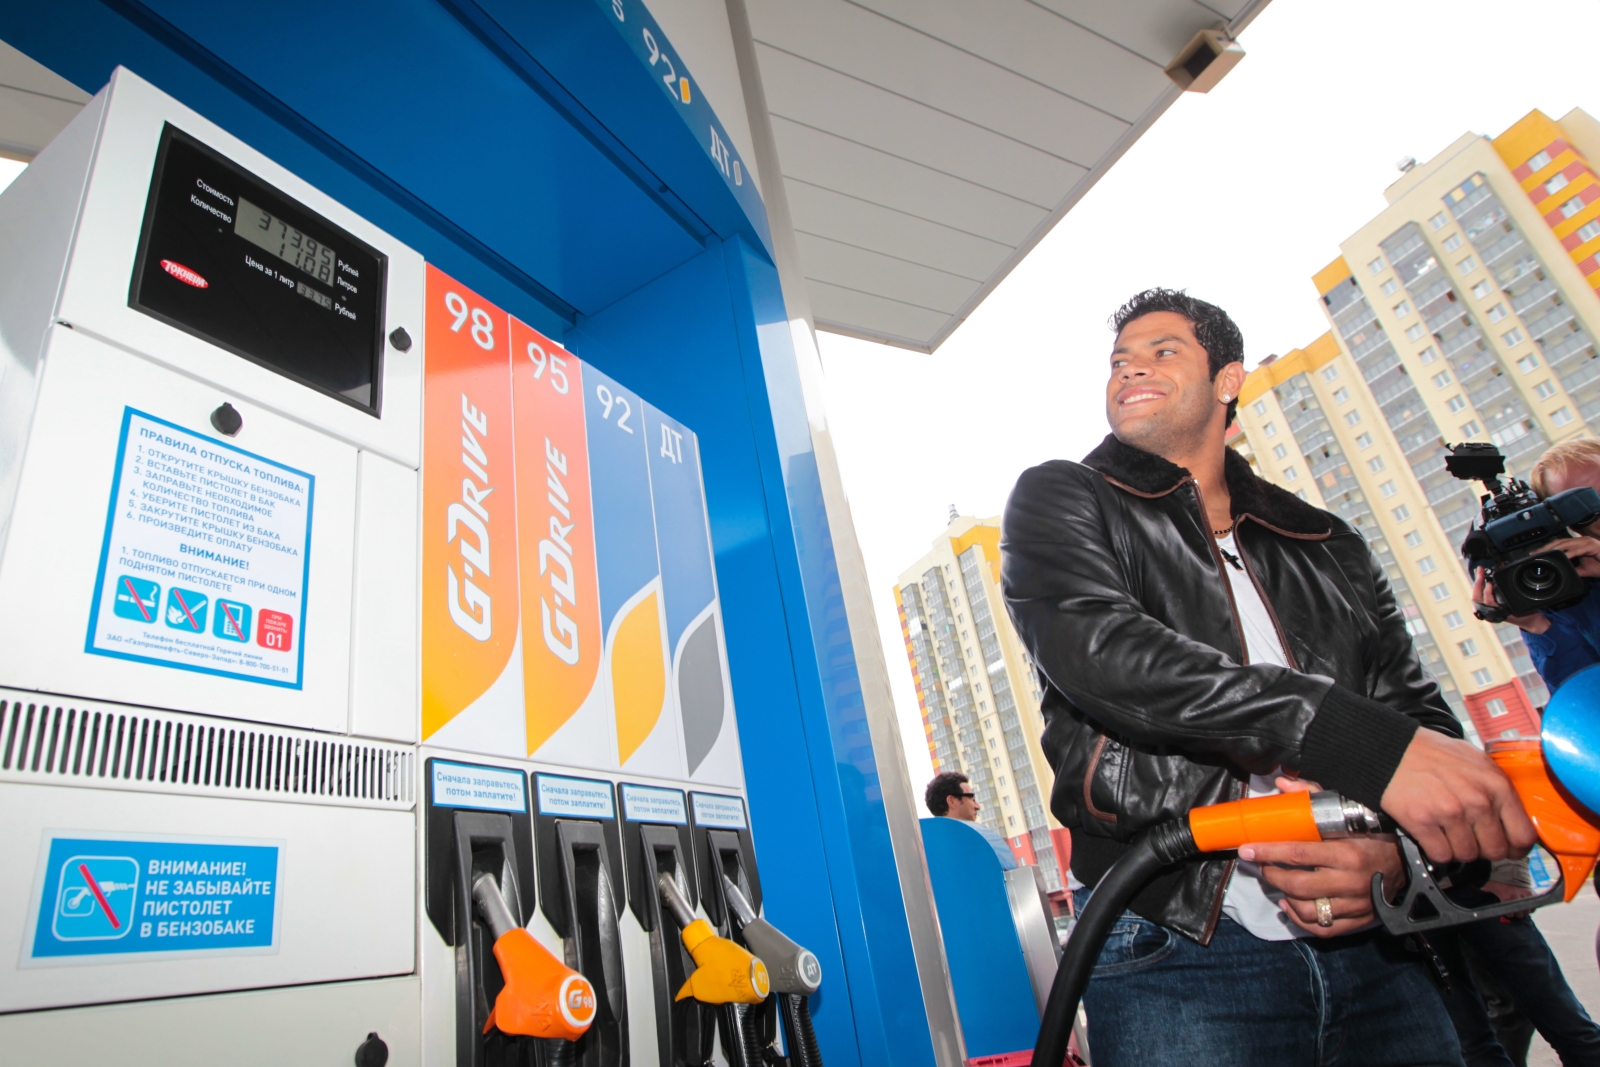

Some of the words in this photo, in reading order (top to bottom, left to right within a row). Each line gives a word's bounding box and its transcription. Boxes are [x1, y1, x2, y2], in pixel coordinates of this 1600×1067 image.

[643, 28, 678, 100] 92
[710, 125, 730, 178] ДТ
[196, 178, 234, 206] Стоимость
[190, 194, 232, 224] Количество
[258, 212, 332, 266] 373.95
[245, 254, 264, 272] Цена
[265, 267, 272, 276] за
[274, 270, 278, 279] 1
[279, 274, 294, 288] литр
[338, 259, 359, 278] Рублей
[337, 276, 358, 294] Литров
[334, 302, 356, 320] Рублей
[446, 292, 494, 350] 98
[527, 342, 569, 394] 95
[597, 384, 633, 434] 92
[660, 423, 682, 464] ДТ
[140, 427, 198, 455] ПРАВИЛА
[200, 450, 250, 474] ОТПУСКА
[254, 468, 304, 494] ТОПЛИВА:
[135, 456, 144, 464] 2.
[147, 460, 197, 482] ВСТАВЬТЕ
[200, 477, 248, 498] ПИСТОЛЕТ
[258, 496, 276, 508] БАК
[138, 445, 145, 454] 1.
[148, 449, 204, 474] ОТКРУТИТЕ
[207, 468, 248, 488] КРЫШКУ
[250, 484, 301, 507] БЕНЗОБАКА
[134, 466, 142, 476] 3.
[145, 470, 202, 495] ЗАПРАВЬТЕ
[206, 490, 272, 518] НЕОБХОДИМОЕ
[142, 480, 208, 507] КОЛИЧЕСТВО
[212, 502, 254, 522] ТОПЛИВА
[128, 500, 137, 508] 5.
[140, 503, 199, 527] ЗАКРУТИТЕ
[202, 522, 244, 540] КРЫШКУ
[247, 534, 298, 556] БЕНЗОБАКА
[130, 489, 138, 498] 4.
[142, 492, 188, 512] УБЕРИТЕ
[190, 507, 240, 528] ПИСТОЛЕТ
[243, 523, 254, 532] ИЗ
[258, 528, 280, 540] БАКА
[126, 511, 135, 520] 6.
[138, 514, 214, 542] ПРОИЗВЕДИТЕ
[216, 536, 252, 552] ОПЛАТУ
[179, 543, 250, 570] ВНИМАНИЕ!
[119, 558, 176, 578] ПОДНЯТОМ
[178, 572, 232, 592] ПИСТОЛЕТЕ
[122, 546, 128, 555] 1.
[132, 549, 179, 567] ТОПЛИВО
[181, 562, 246, 585] ОТПУСКАЕТСЯ
[248, 579, 265, 590] ПРИ
[267, 584, 296, 598] ОДНОМ
[106, 634, 122, 642] ЗАО
[143, 632, 173, 643] Телефон
[175, 639, 214, 651] бесплатной
[217, 647, 242, 656] Горячей
[266, 632, 282, 648] 01
[437, 772, 471, 785] Сначала
[473, 778, 521, 791] заправьтесь,
[446, 787, 471, 797] потом
[473, 789, 516, 801] заплатите!
[541, 784, 568, 795] Сначала
[570, 789, 610, 800] заправьтесь,
[549, 798, 568, 806] потом
[571, 800, 606, 809] заплатите!
[626, 794, 649, 803] Сначала
[148, 860, 246, 876] ВНИМАНИЕ!
[145, 881, 169, 895] НЕ
[173, 878, 271, 895] ЗАБЫВАЙТЕ
[142, 900, 232, 916] ПИСТОЛЕТ
[140, 922, 152, 938] В
[157, 920, 255, 937] БЕНЗОБАКЕ
[758, 971, 767, 984] 92
[807, 963, 817, 977] ДТ
